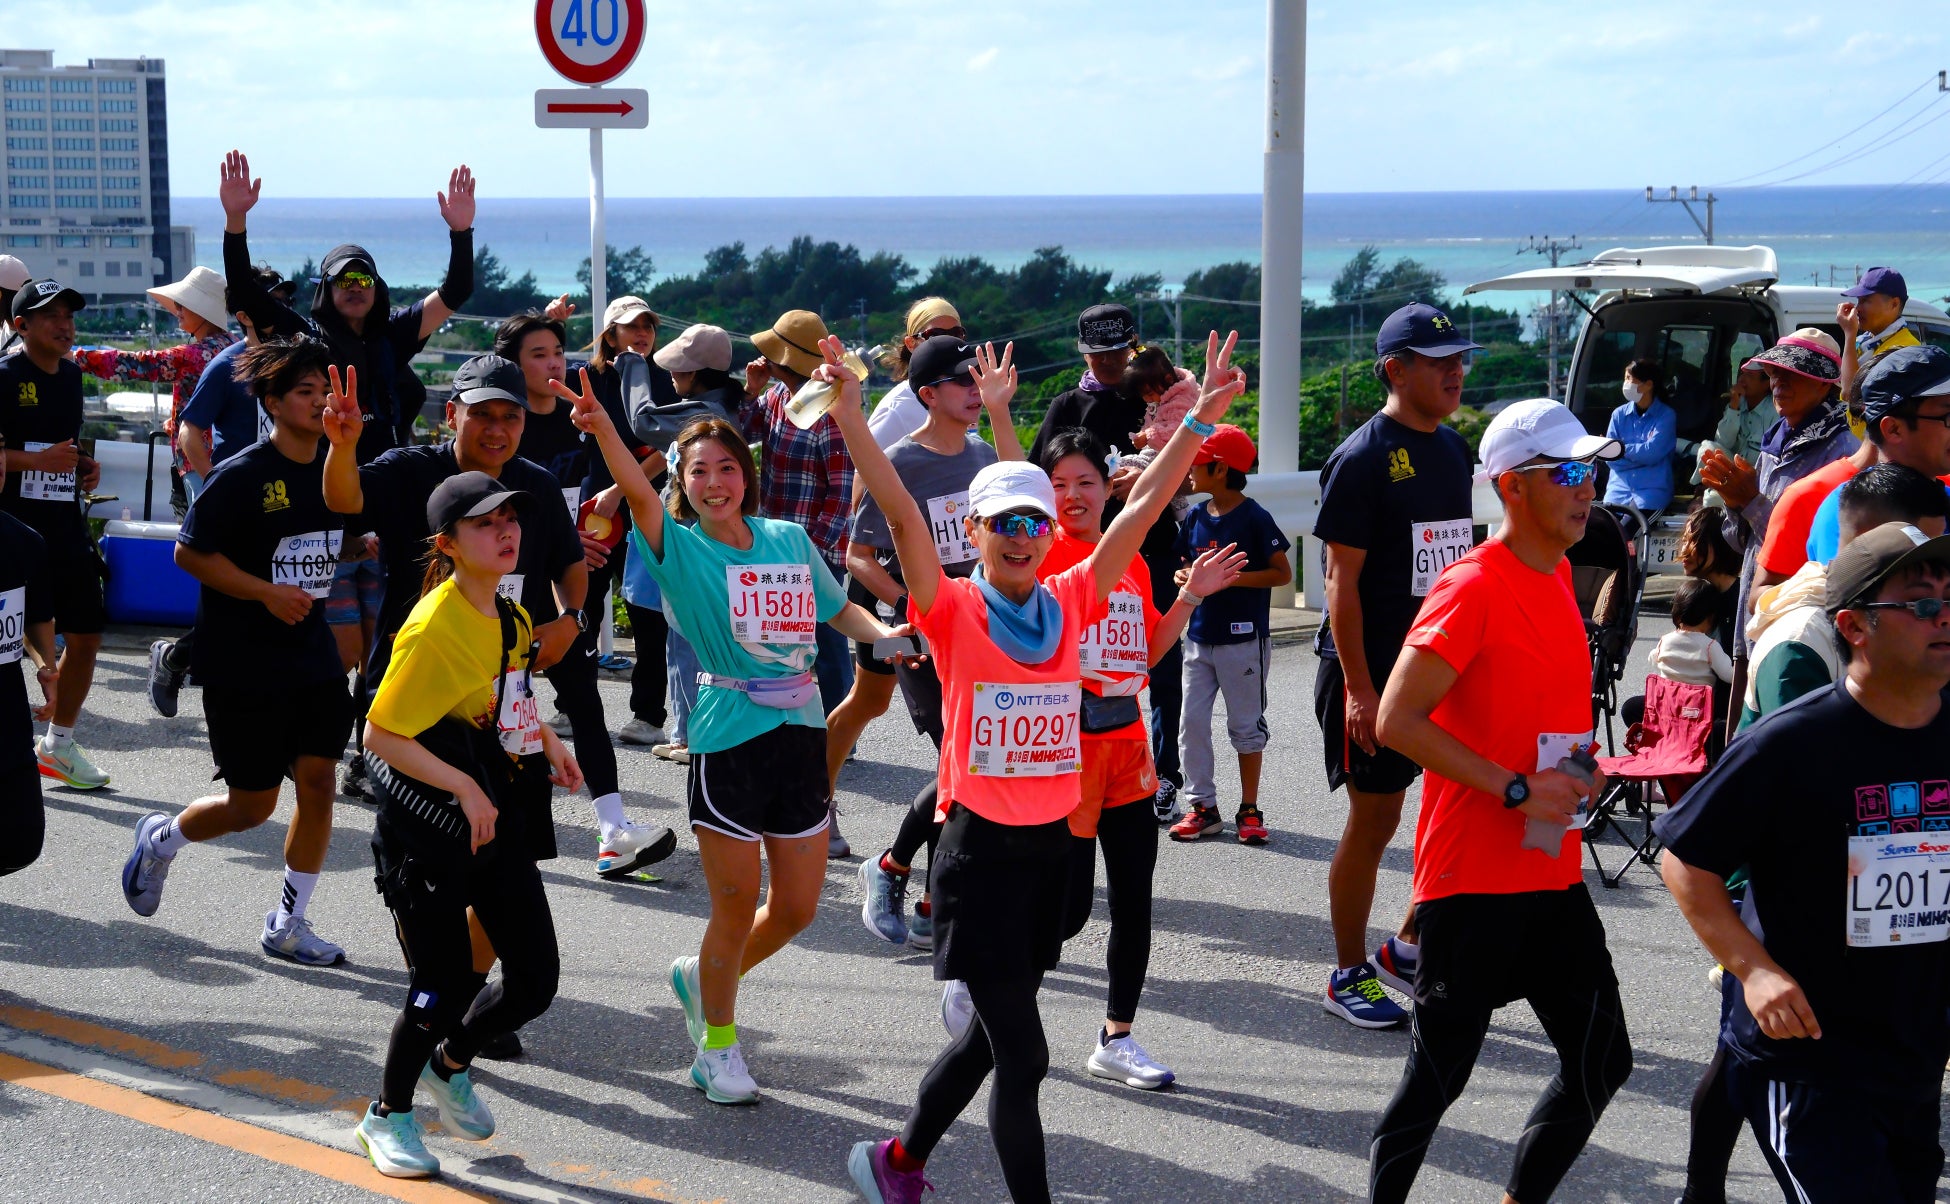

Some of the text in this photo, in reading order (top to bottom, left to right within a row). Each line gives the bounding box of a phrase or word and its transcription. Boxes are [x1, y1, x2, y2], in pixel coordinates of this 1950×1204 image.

[560, 0, 618, 46] 40
[1388, 448, 1410, 472] 39
[263, 480, 286, 503] 39
[761, 572, 812, 586] 琉球銀行
[733, 590, 815, 617] J15816
[1017, 694, 1070, 706] NTT西日本
[975, 712, 1077, 747] G10297
